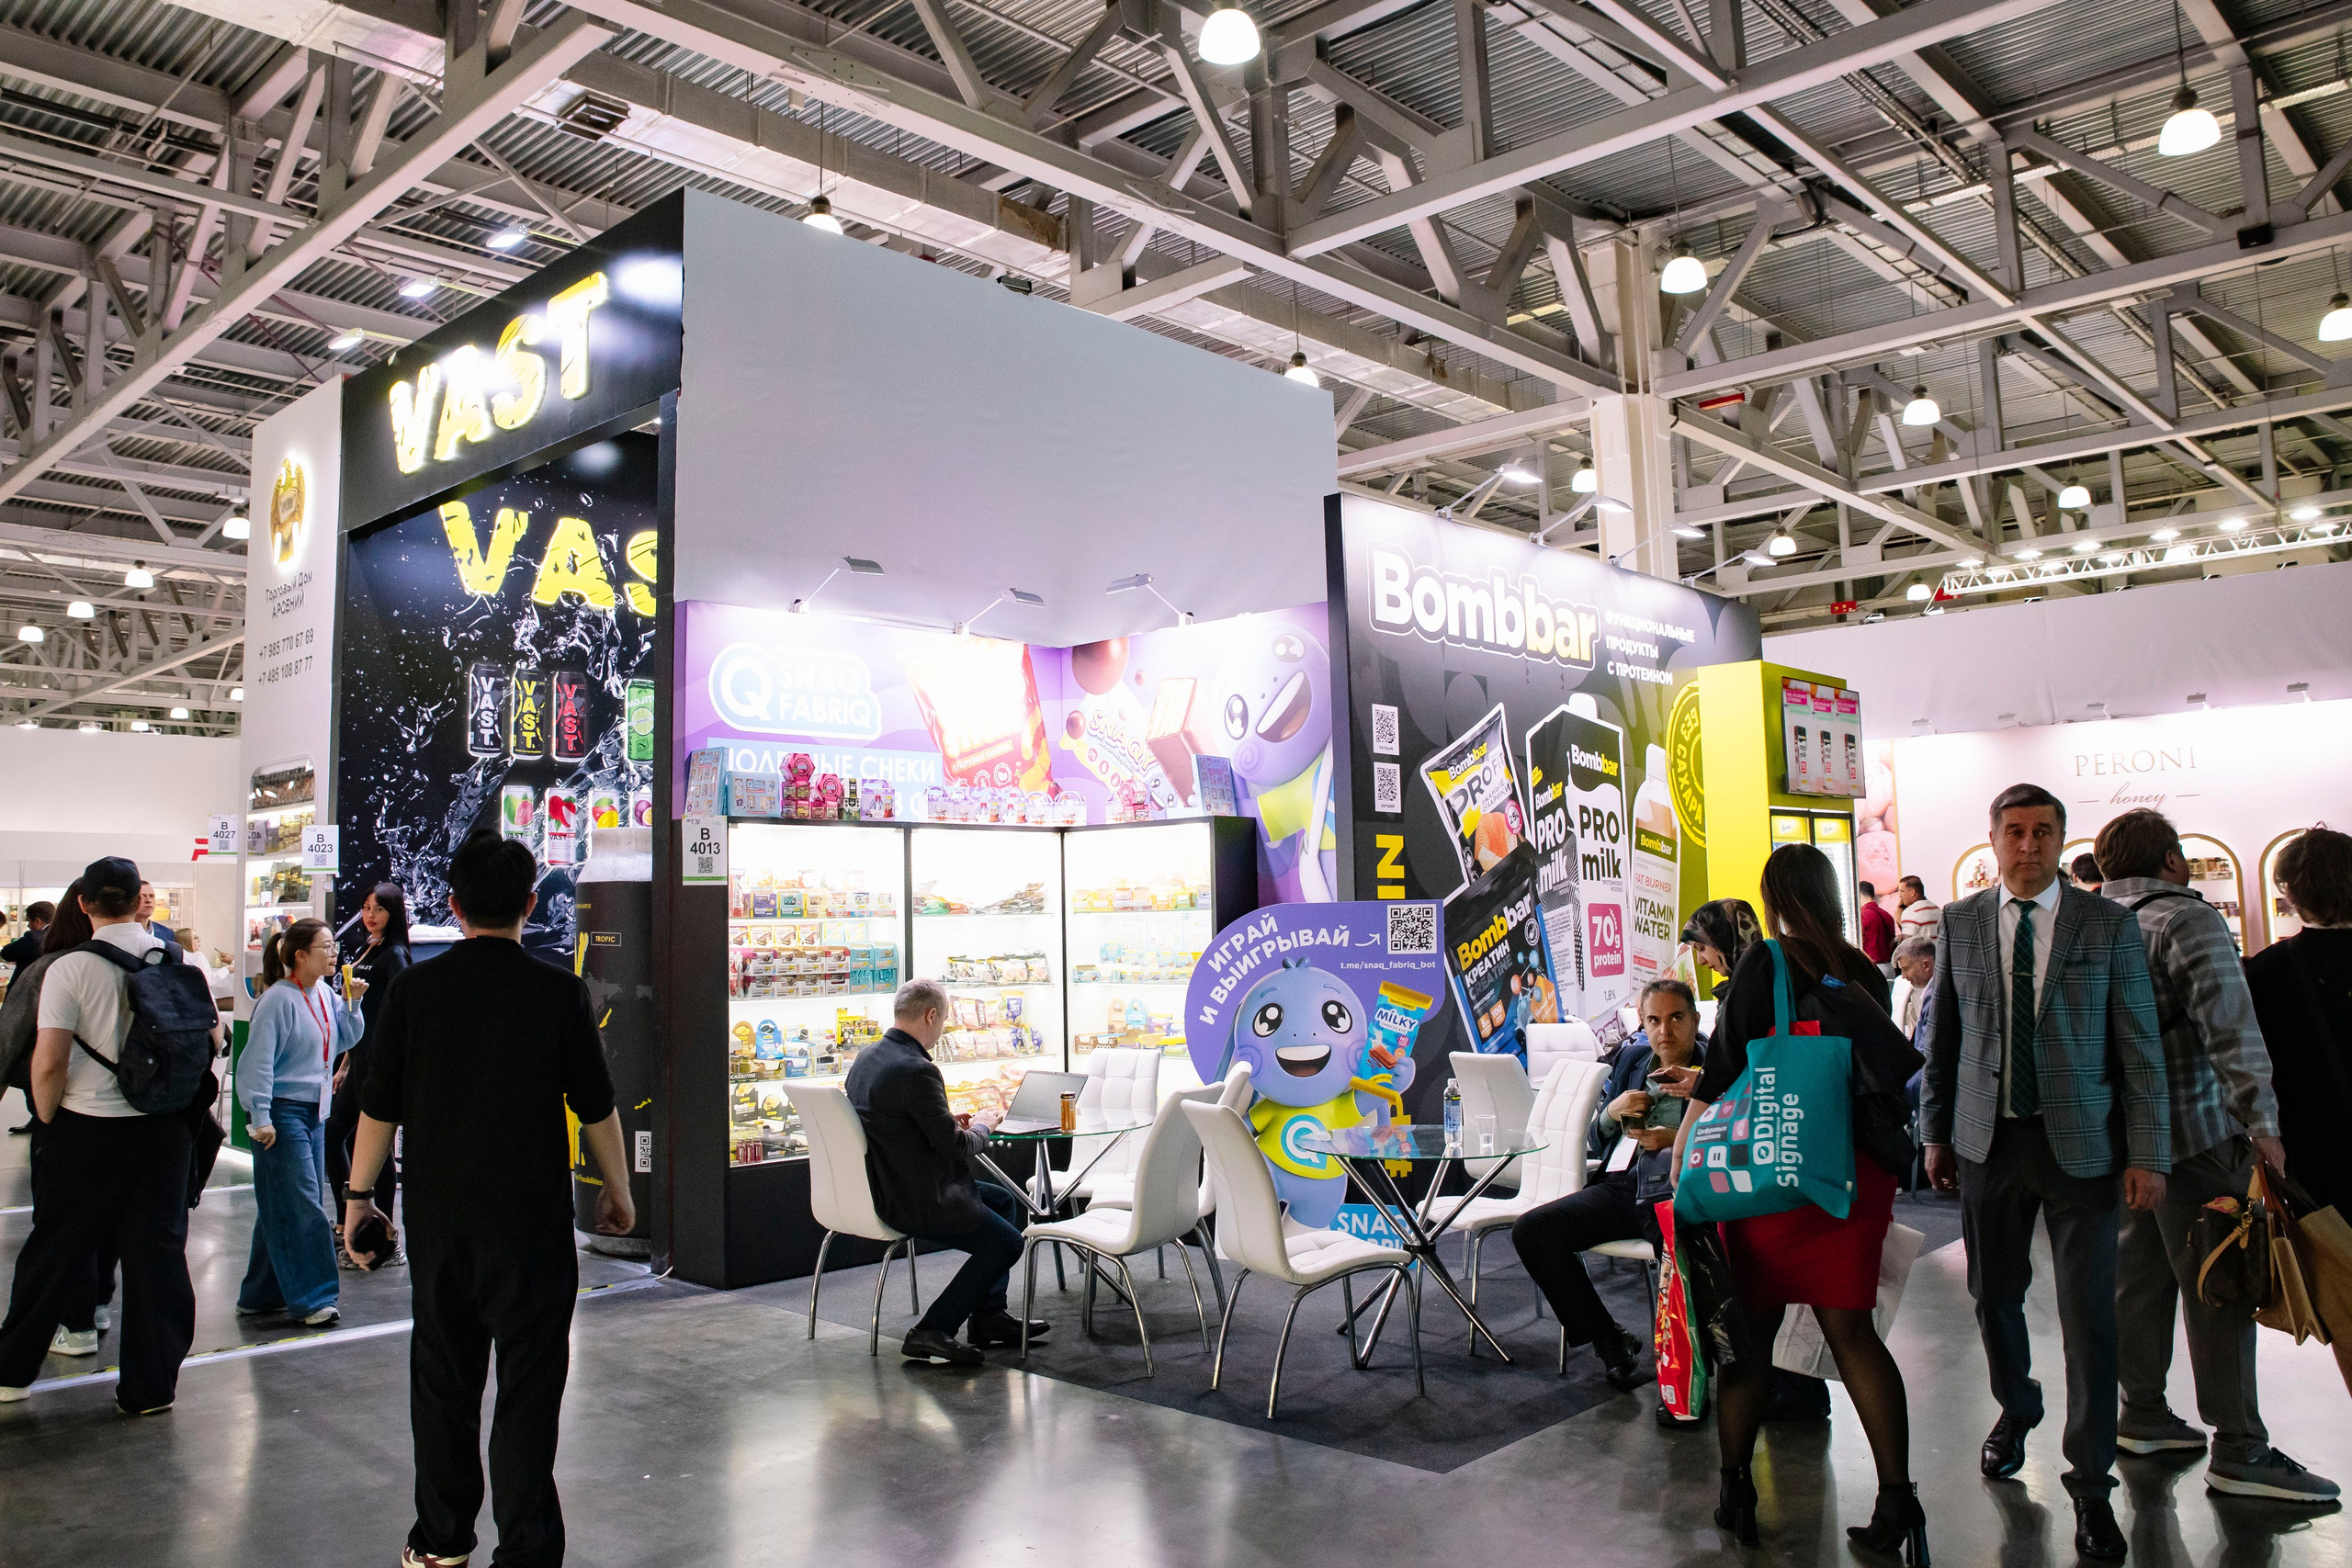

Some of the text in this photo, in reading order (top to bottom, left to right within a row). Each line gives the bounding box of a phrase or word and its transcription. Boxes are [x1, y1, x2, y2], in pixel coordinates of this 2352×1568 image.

[389, 272, 608, 474] VAST
[266, 570, 313, 603] Торговый Дом
[271, 589, 305, 620] АРСЕНИЙ
[1373, 549, 1598, 664] Bombbar
[1604, 609, 1696, 644] ФУНКЦИОНАЛЬНЫЕ
[259, 628, 314, 660] +7 985 770 67 69
[1605, 634, 1659, 660] ПРОДУКТЫ
[258, 655, 313, 686] +7 495 108 87 77
[777, 660, 861, 696] SNAQ
[1607, 661, 1674, 686] С ПРОТЕИНОМ
[480, 676, 495, 746] VAST
[522, 680, 537, 749] VAST
[563, 683, 578, 751] VAST
[628, 694, 654, 708] MOJIT
[779, 693, 873, 728] FABRIQ
[1680, 705, 1700, 742] БЕЗ
[859, 755, 936, 784] СНЕКИ
[1448, 741, 1487, 781] Bombbar
[1570, 743, 1619, 778] Bombbar
[2075, 746, 2198, 778] PERONI
[1535, 781, 1564, 811] Bombbar
[1676, 743, 1702, 825] САХАРА
[2109, 782, 2168, 810] honey
[212, 830, 236, 839] 4027
[220, 821, 229, 830] B
[316, 833, 325, 843] B
[700, 828, 710, 840] B
[1536, 807, 1566, 855] PRO
[1578, 803, 1621, 845] PRO
[307, 843, 334, 853] 4023
[690, 841, 721, 855] 4013
[1640, 833, 1672, 856] Bombbar
[1539, 848, 1568, 895] milk
[1581, 847, 1623, 882] milk
[1645, 875, 1672, 894] BURNER
[1634, 895, 1675, 924] VITAMIN
[594, 935, 616, 943] TROPIC
[1206, 913, 1280, 975] ИГРАЙ
[1456, 892, 1532, 972] Bombbar
[1634, 914, 1670, 942] WATER
[1198, 924, 1351, 1025] И ВЫИГРЫВАЙ
[1340, 960, 1436, 971] t.me/snaq_fabriq_bot
[1464, 939, 1510, 988] КРЕАТИН
[1469, 953, 1514, 1000] CREATINE
[1381, 1021, 1407, 1034] CHOCOLATE
[1399, 1035, 1408, 1043] NO
[1753, 1066, 1781, 1141] Digital
[1775, 1093, 1805, 1188] Signage
